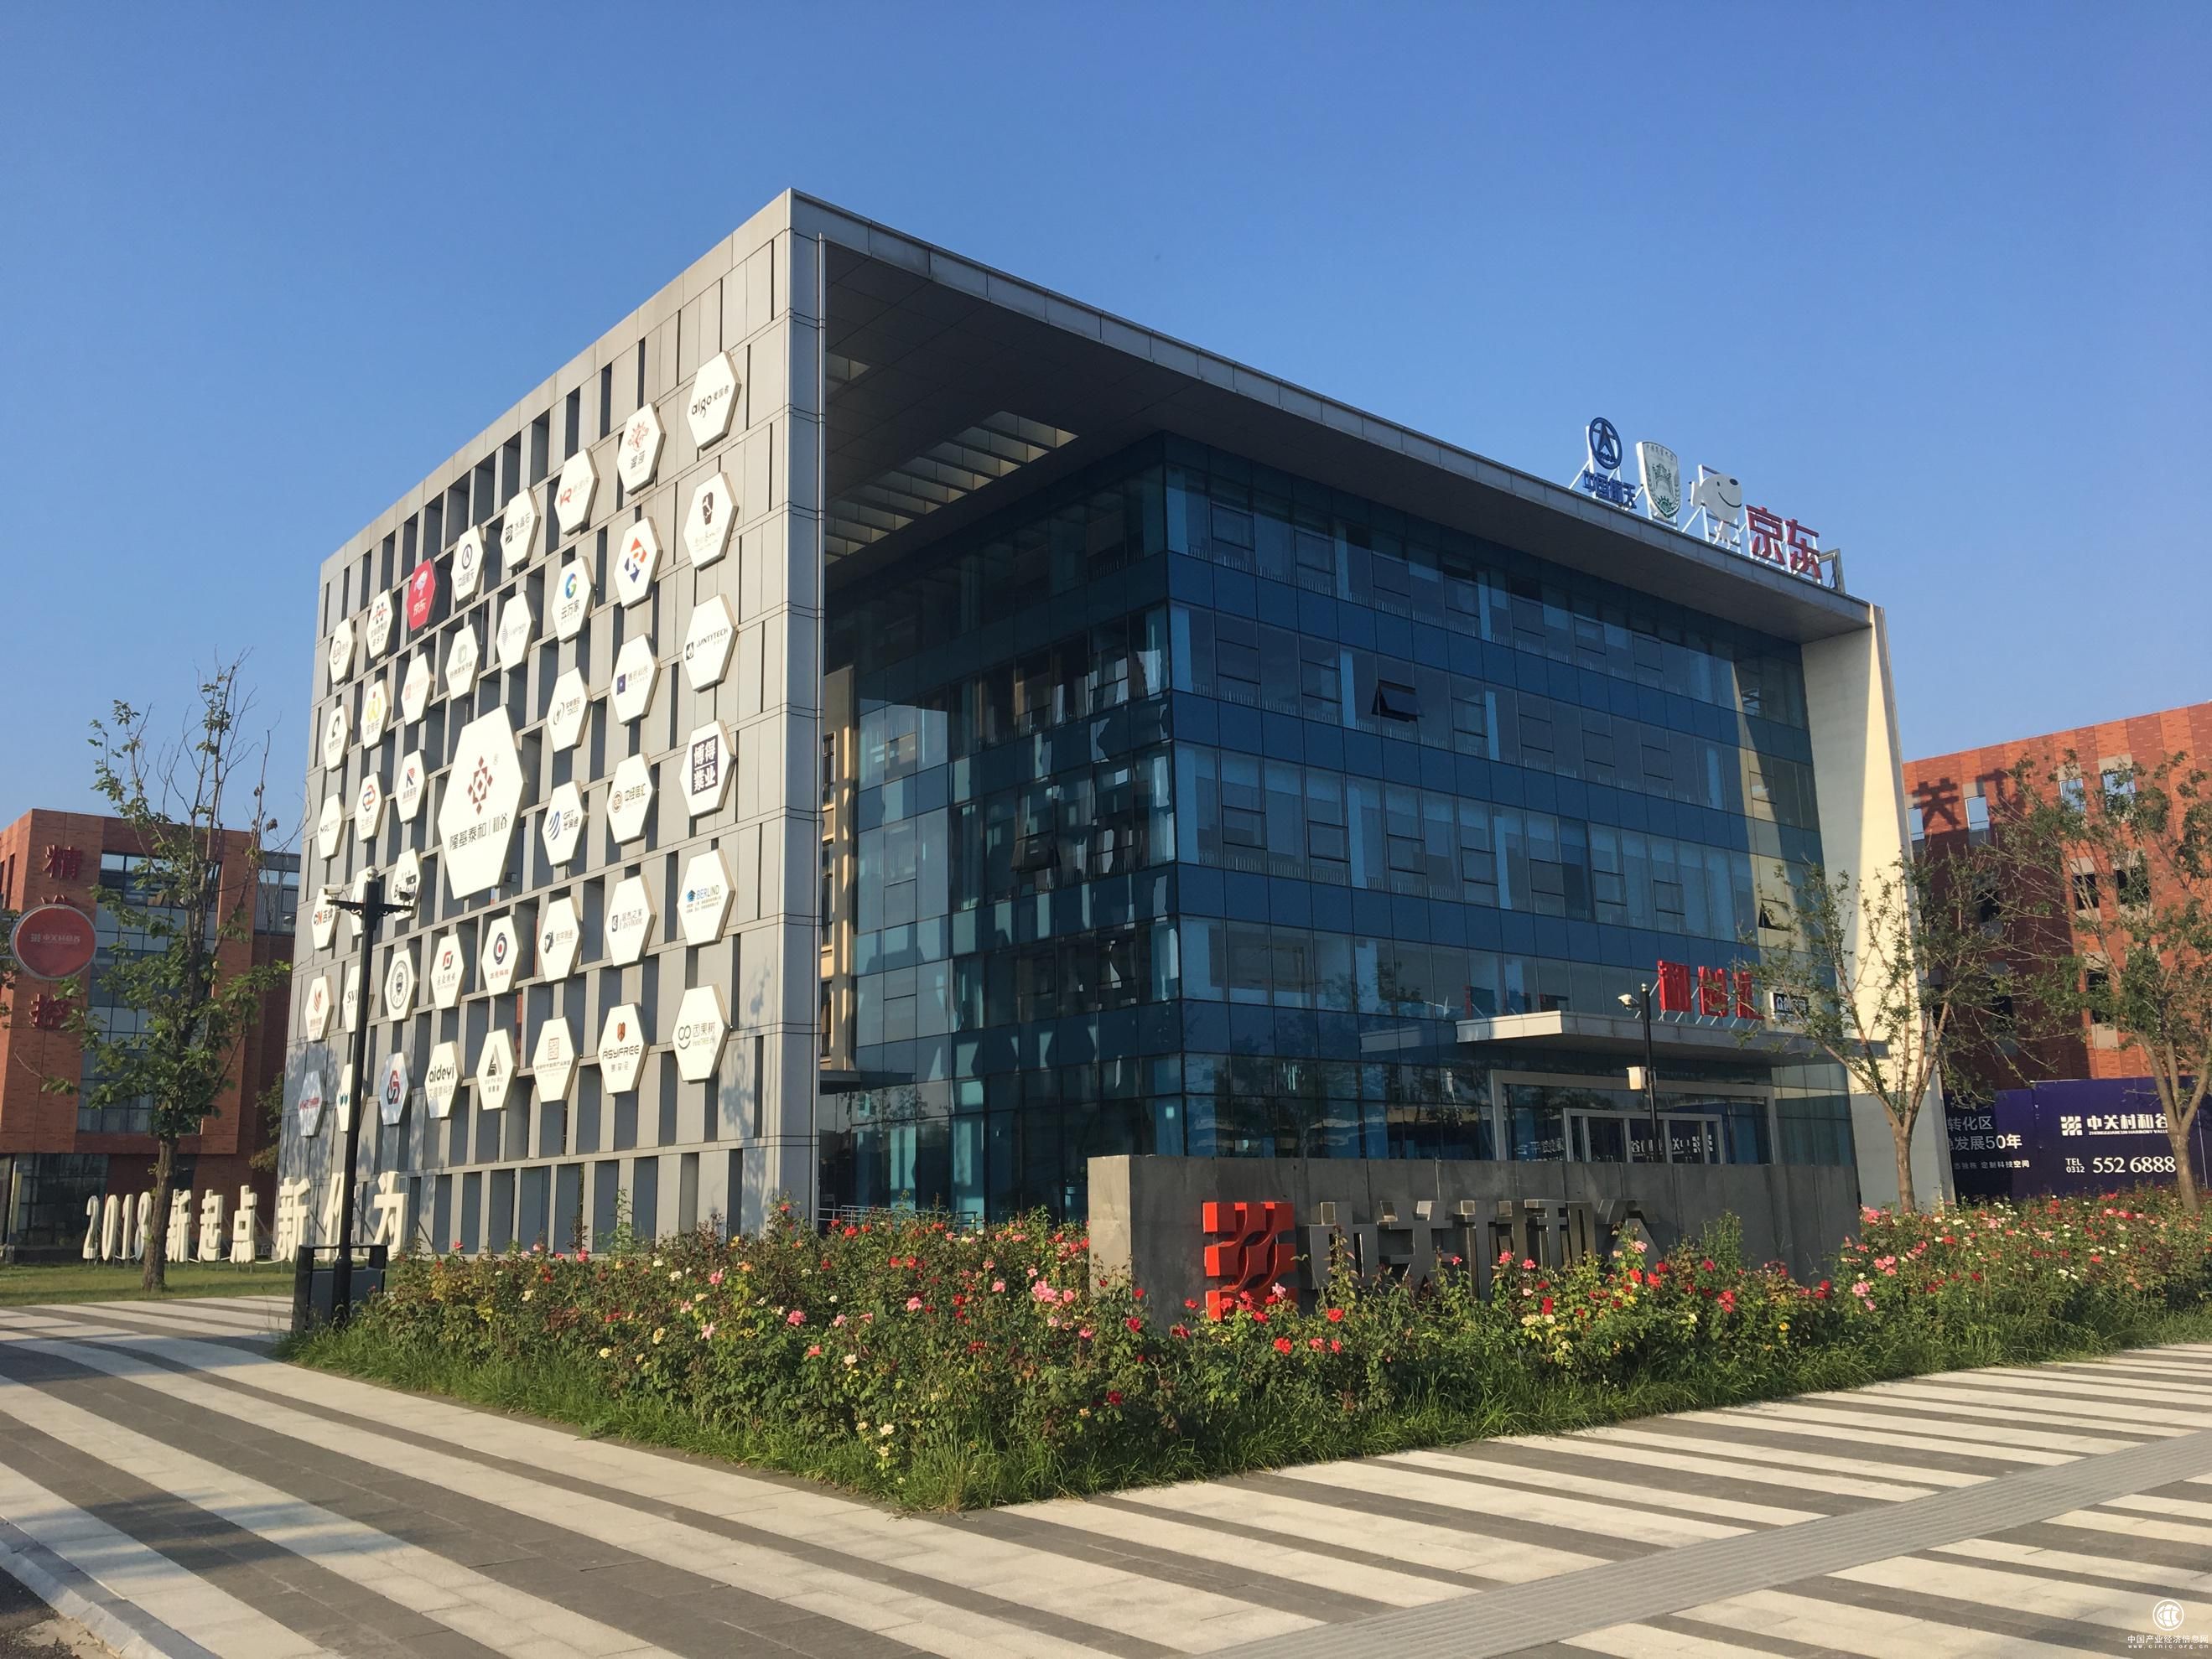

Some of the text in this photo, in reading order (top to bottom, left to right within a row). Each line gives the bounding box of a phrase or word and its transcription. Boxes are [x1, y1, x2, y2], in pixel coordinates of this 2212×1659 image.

[691, 395, 712, 418] aigo
[1582, 469, 1638, 510] 中国航天
[1746, 504, 1823, 579] 京东
[696, 884, 719, 900] BERLIND
[693, 1021, 715, 1038] 因果树
[428, 1063, 454, 1083] aideyi
[1947, 1116, 1993, 1131] 转化区
[2086, 1113, 2168, 1130] 中关村和谷
[2065, 1158, 2082, 1166] TEL
[2093, 1156, 2176, 1174] 552 6888
[82, 1191, 152, 1261] 2018
